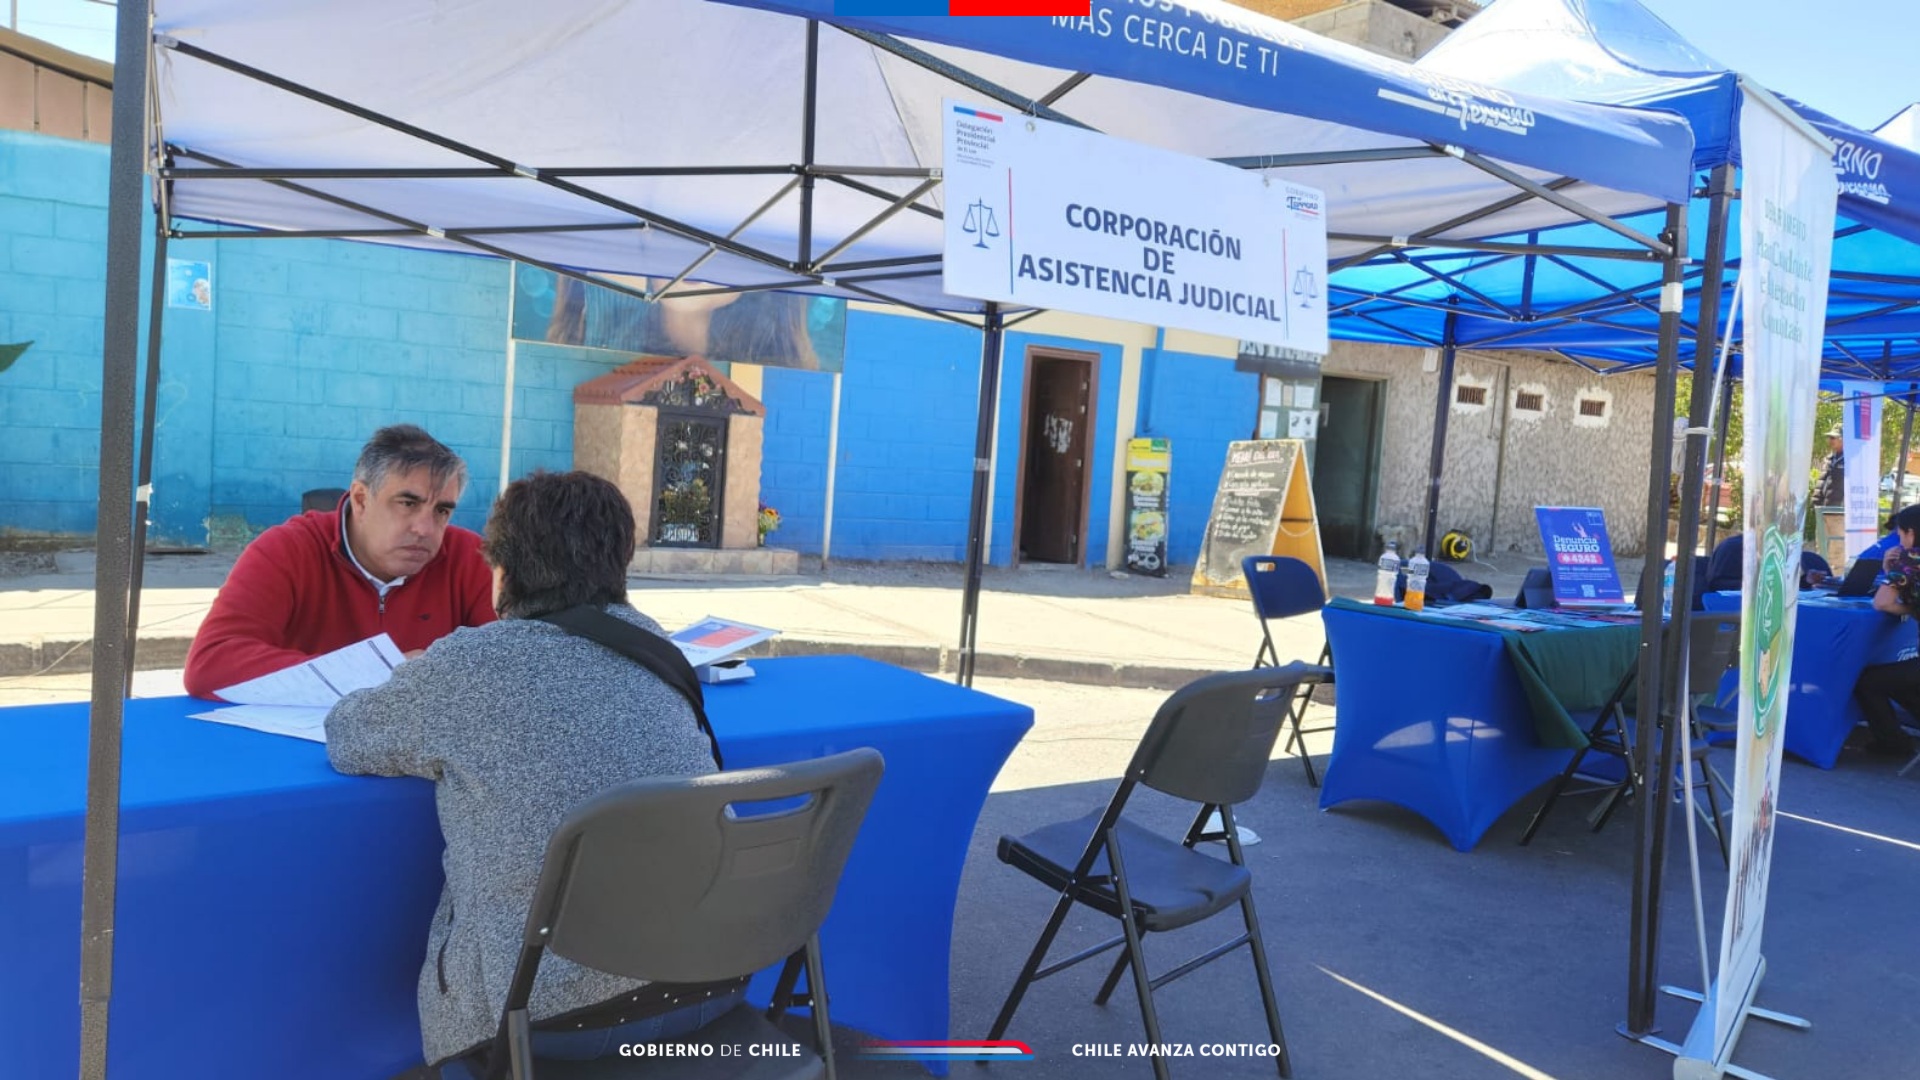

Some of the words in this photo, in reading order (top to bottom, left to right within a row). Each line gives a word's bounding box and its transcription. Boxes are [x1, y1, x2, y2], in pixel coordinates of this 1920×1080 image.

[1123, 14, 1207, 60] CERCA
[1217, 37, 1249, 69] DE
[1257, 47, 1279, 77] TI
[1065, 203, 1241, 261] CORPORACIÓN
[1143, 246, 1176, 275] DE
[1018, 253, 1172, 303] ASISTENCIA
[1178, 282, 1281, 322] JUDICIAL
[1553, 535, 1598, 544] Denuncia
[1555, 543, 1600, 553] SEGURO
